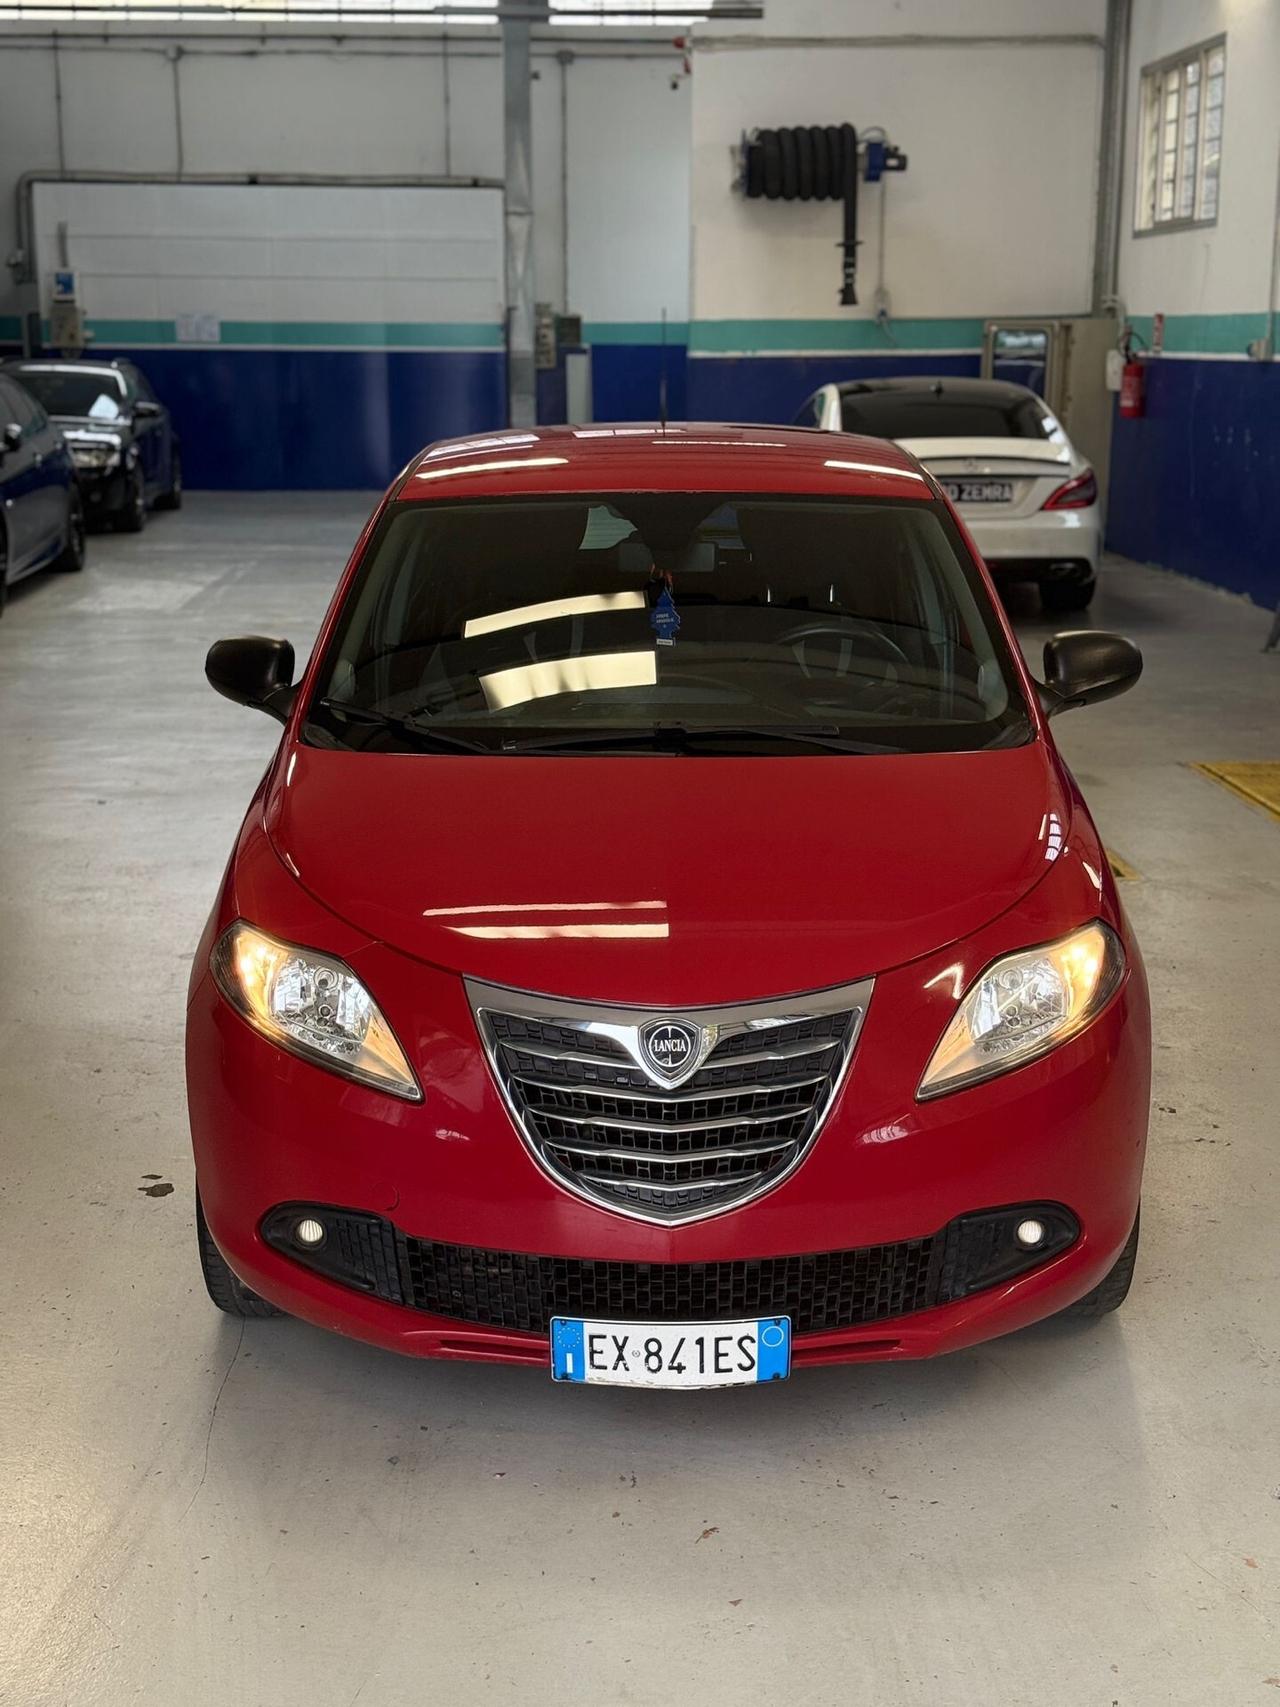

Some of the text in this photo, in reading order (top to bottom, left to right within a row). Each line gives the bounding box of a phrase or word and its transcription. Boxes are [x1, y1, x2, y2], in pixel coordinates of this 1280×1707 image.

[654, 1039, 687, 1052] LANCIA
[588, 1334, 630, 1371] EX
[644, 1334, 756, 1374] 841ES
